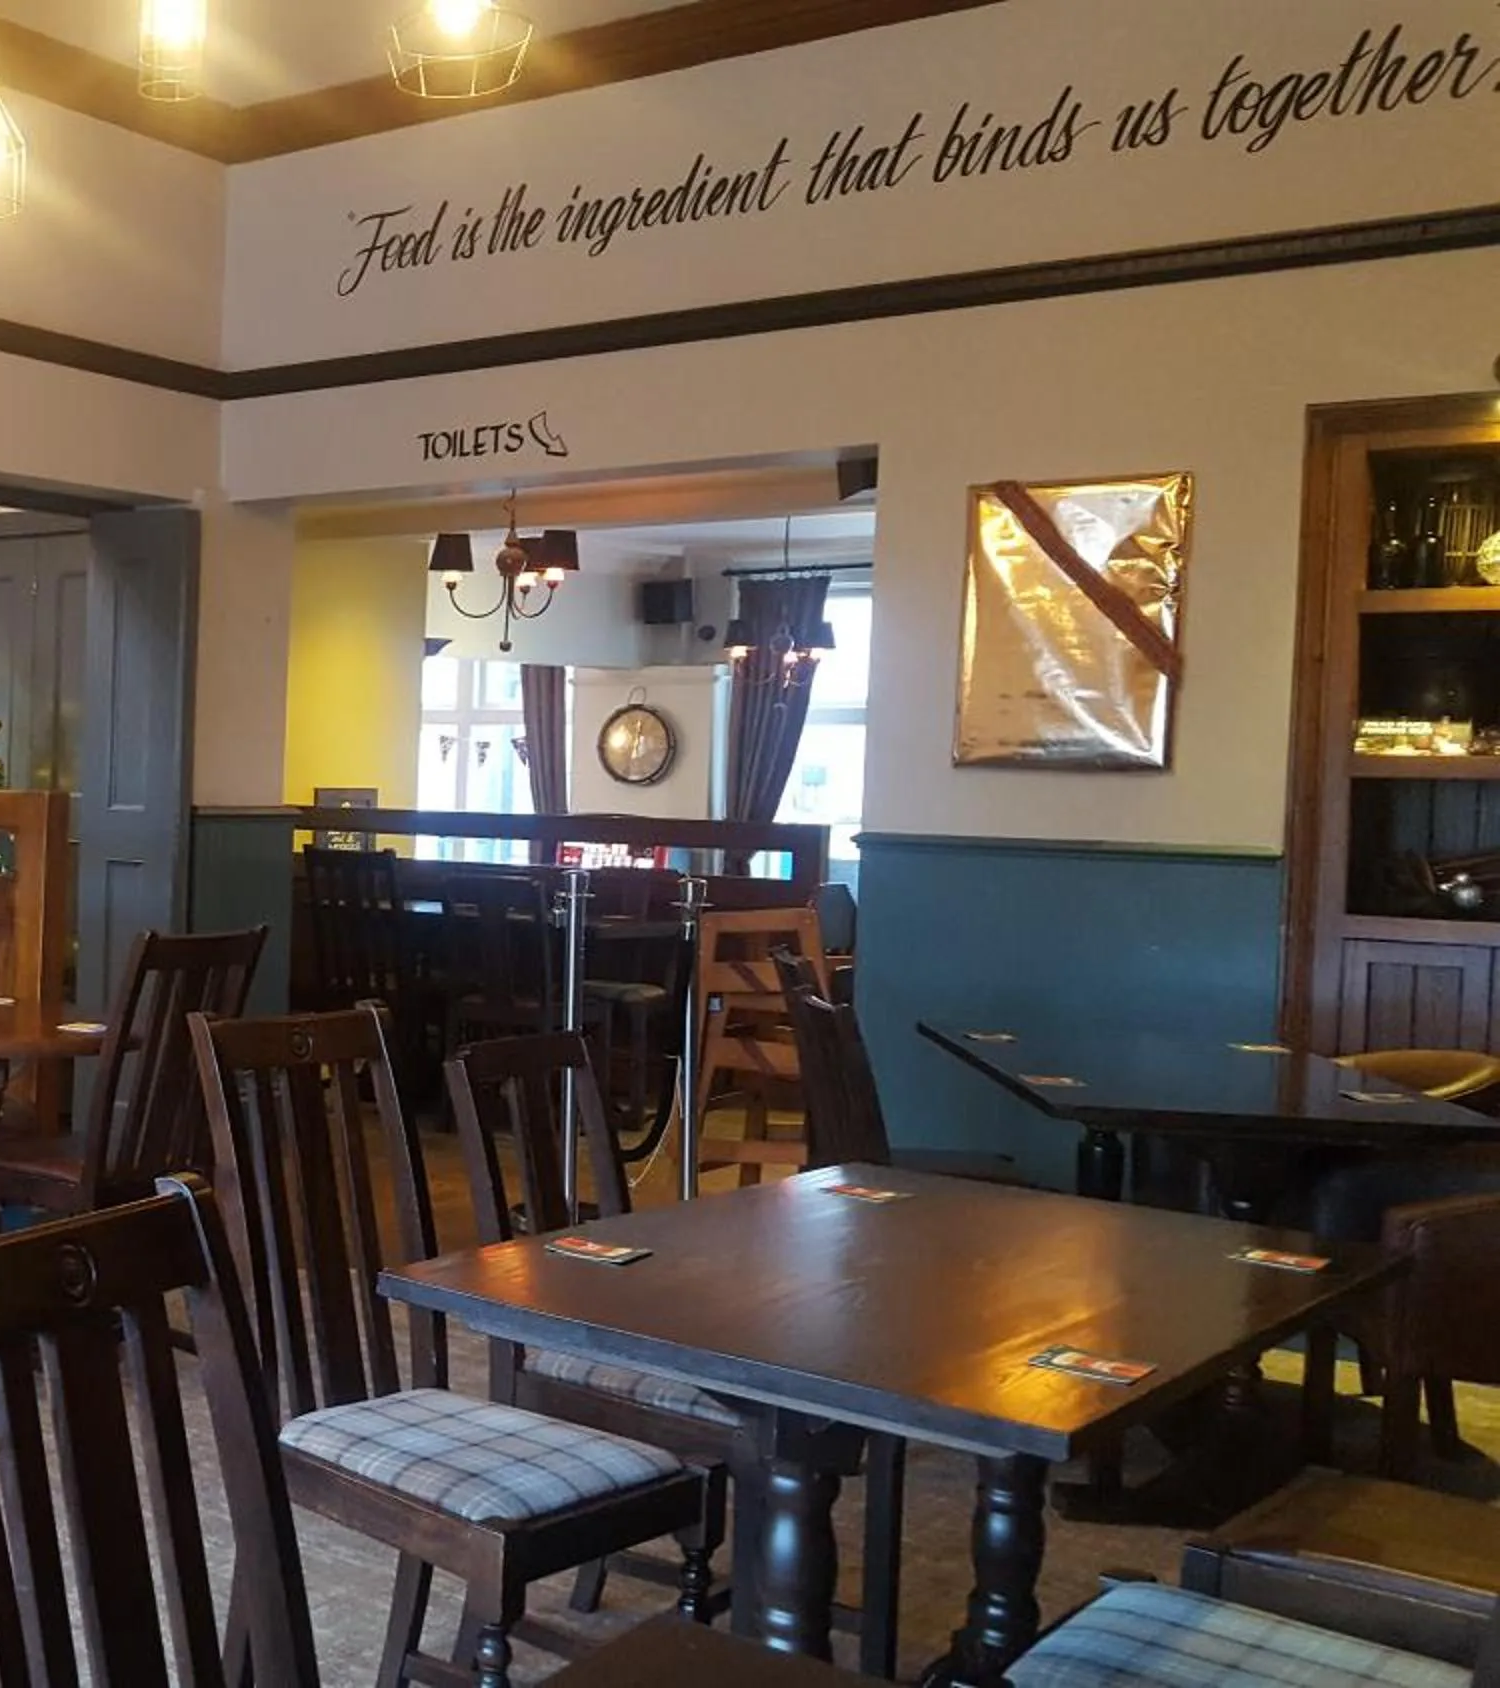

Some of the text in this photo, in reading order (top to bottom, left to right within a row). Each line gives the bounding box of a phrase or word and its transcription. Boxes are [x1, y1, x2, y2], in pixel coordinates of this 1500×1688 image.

[337, 200, 448, 296] Food
[451, 207, 482, 261] is
[487, 183, 546, 255] the
[556, 137, 791, 257] ingredient
[805, 112, 925, 204] that
[932, 85, 1101, 183] binds
[1110, 87, 1188, 152] us
[417, 423, 524, 461] TOILETS
